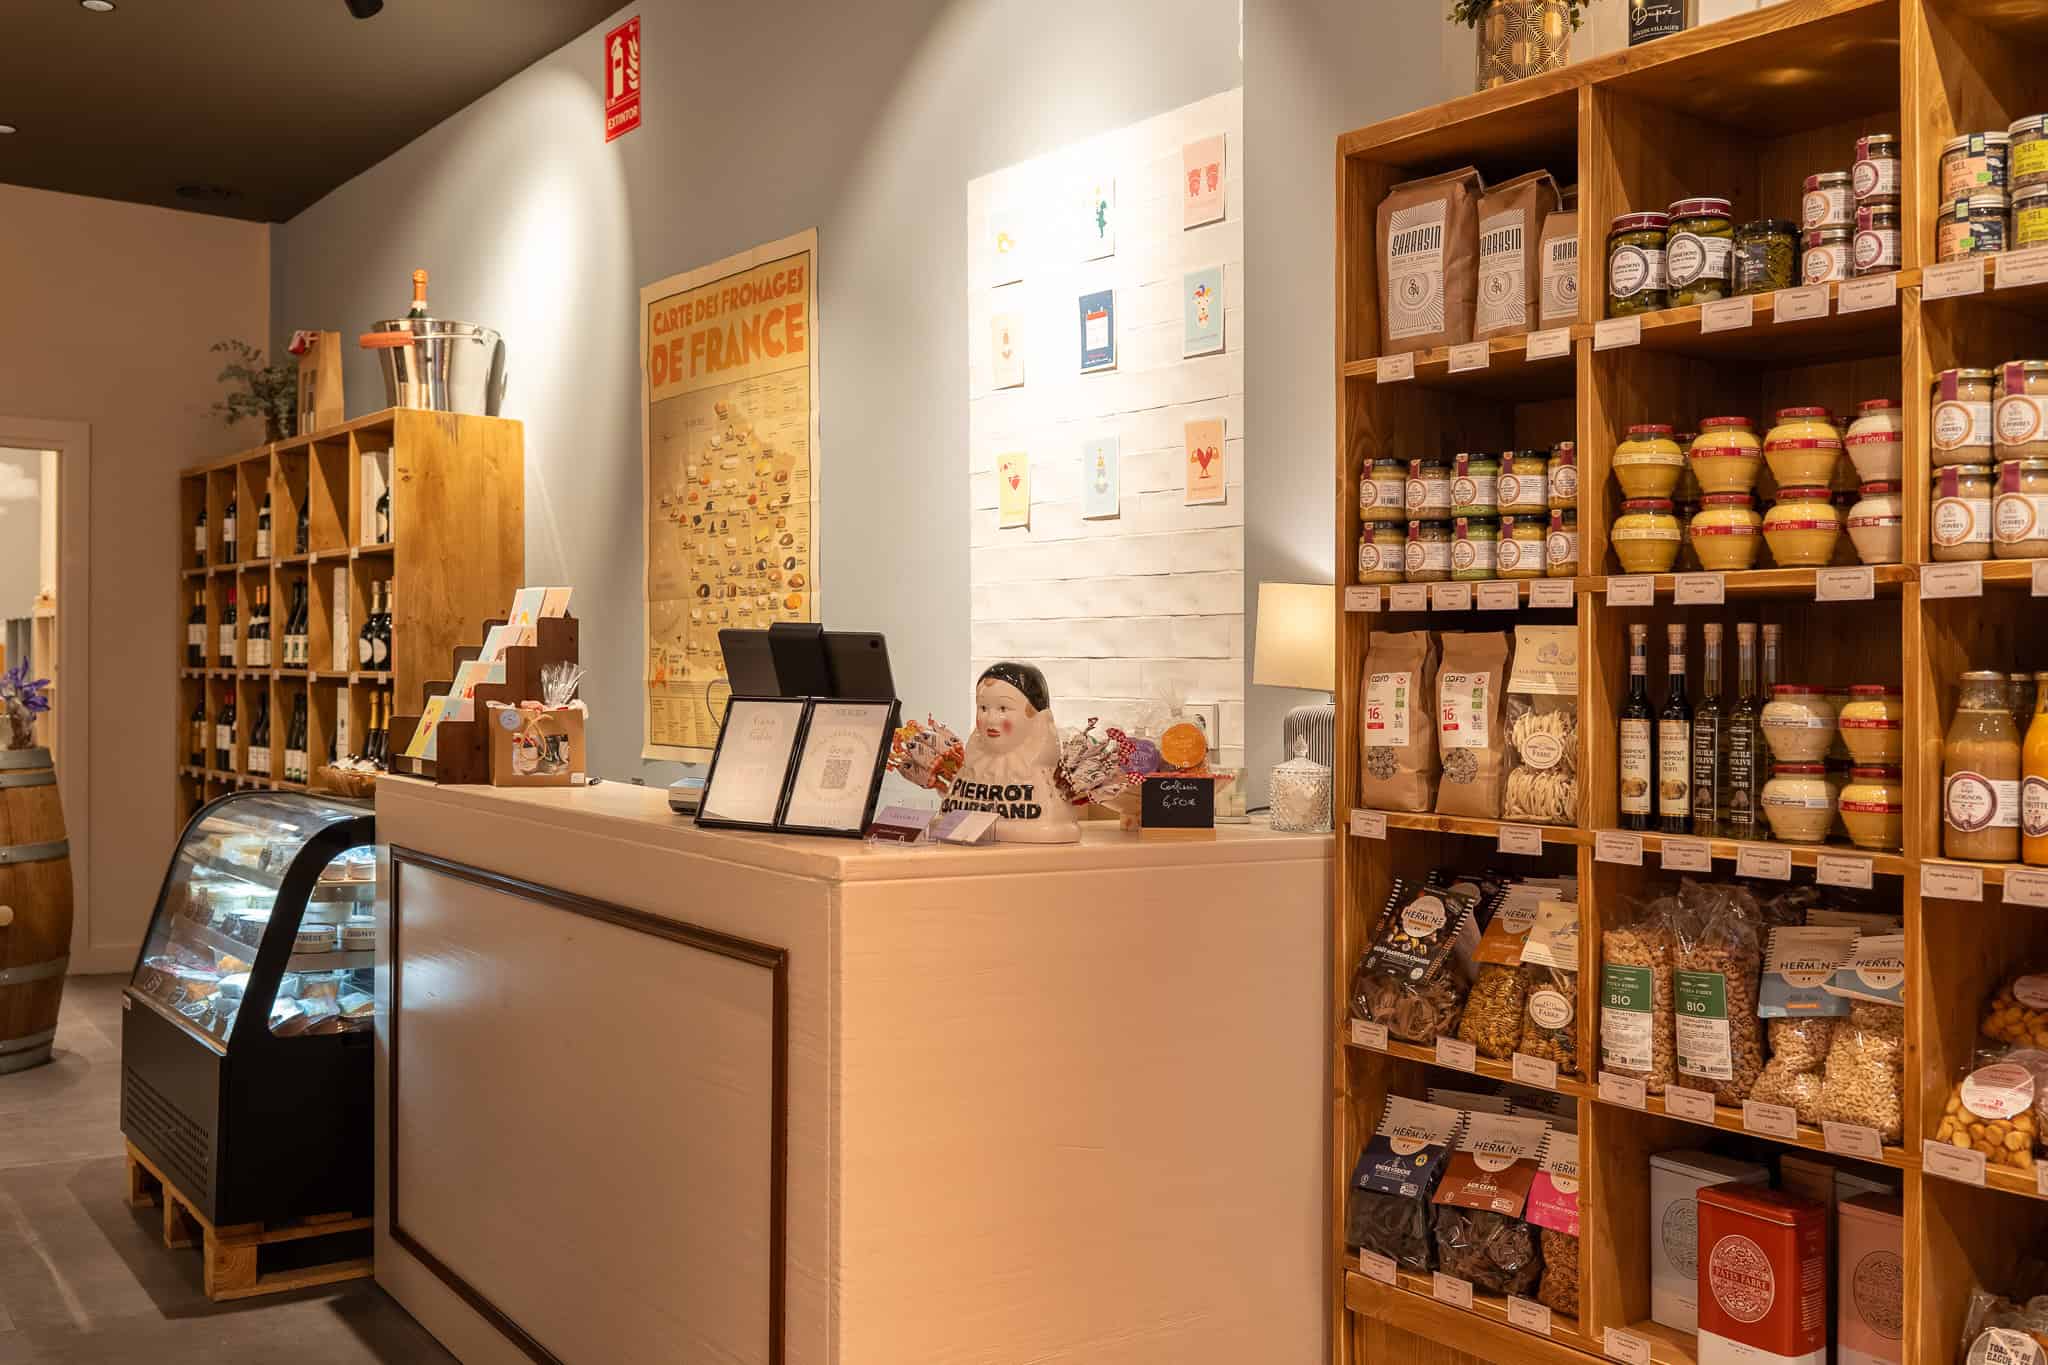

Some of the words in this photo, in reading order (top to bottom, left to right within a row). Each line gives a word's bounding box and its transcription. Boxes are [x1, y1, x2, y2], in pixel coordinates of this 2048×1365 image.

[1391, 225, 1441, 257] SARRASIN
[653, 302, 692, 336] CARTE
[695, 293, 720, 322] DES
[722, 265, 804, 314] FROMAGES
[651, 337, 685, 388] DE
[690, 303, 804, 378] FRANCE
[1367, 706, 1380, 720] 16
[1443, 707, 1454, 721] 16
[951, 778, 1034, 801] PIERROT
[1505, 908, 1537, 921] HERMIN
[1856, 959, 1904, 969] HERMIN
[1611, 994, 1631, 1006] BIO
[1686, 1001, 1706, 1013] BIO
[1552, 1161, 1577, 1176] HERM
